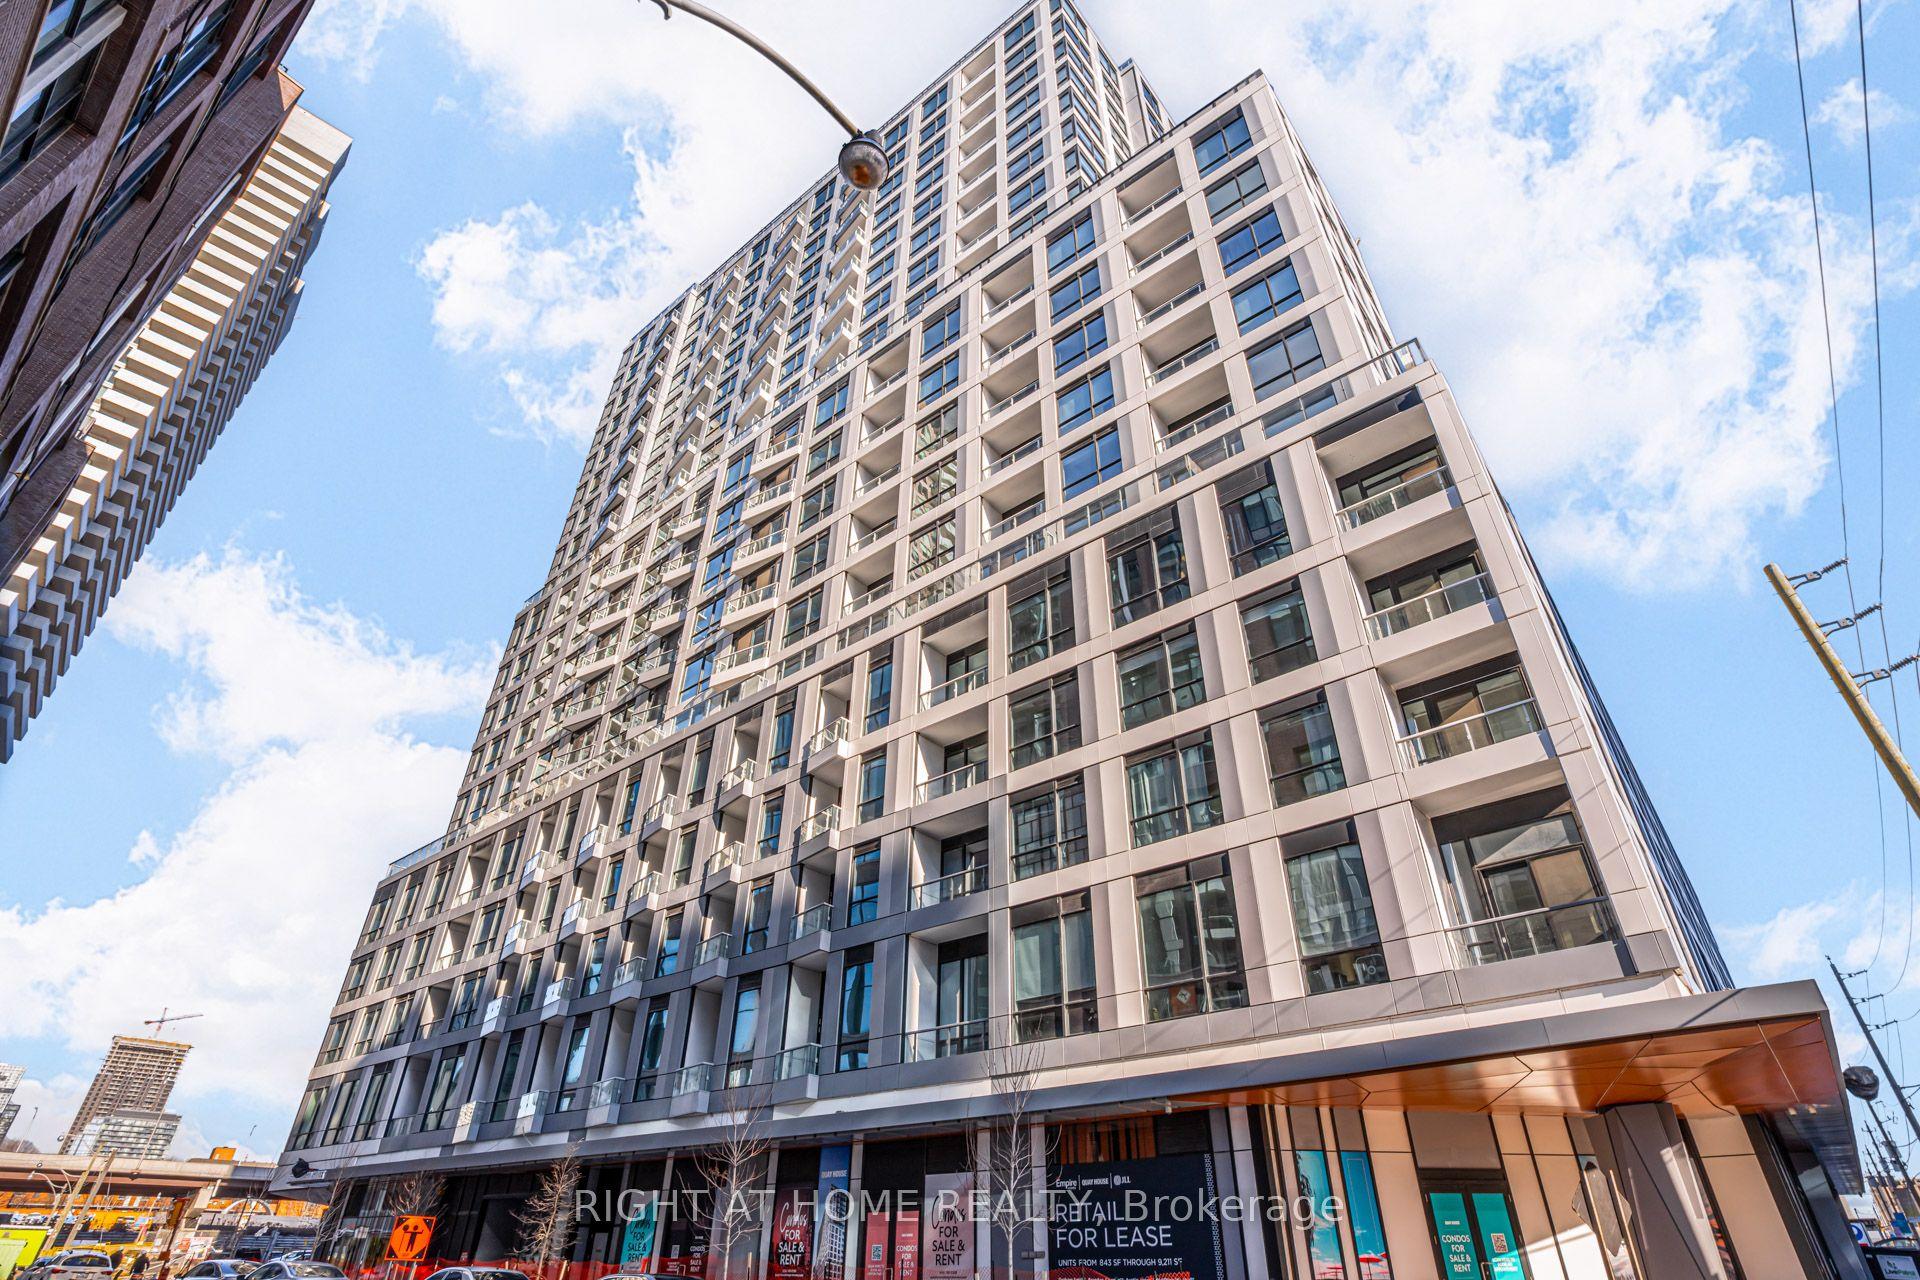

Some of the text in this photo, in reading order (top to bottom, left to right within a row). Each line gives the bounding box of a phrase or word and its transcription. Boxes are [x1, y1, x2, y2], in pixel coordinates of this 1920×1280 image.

[833, 1169, 848, 1177] HOUSE
[1056, 1179, 1077, 1189] Empire
[1055, 1200, 1125, 1223] RETAIL
[632, 1231, 646, 1241] FOR
[784, 1230, 801, 1240] FOR
[939, 1226, 959, 1238] FOR
[1056, 1225, 1173, 1248] FOR LEASE
[1441, 1234, 1471, 1243] CONDOS
[627, 1242, 642, 1252] SALE
[778, 1241, 805, 1253] SALE &
[932, 1240, 966, 1252] SALE &
[1451, 1244, 1466, 1253] FOR
[627, 1253, 644, 1263] RENT
[779, 1253, 802, 1265] RENT
[935, 1253, 962, 1266] RENT
[1058, 1259, 1077, 1267] UNITS
[1078, 1259, 1098, 1267] FROM
[1123, 1258, 1157, 1266] THROUGH
[1449, 1254, 1472, 1263] SALE &
[1453, 1264, 1471, 1273] RENT
